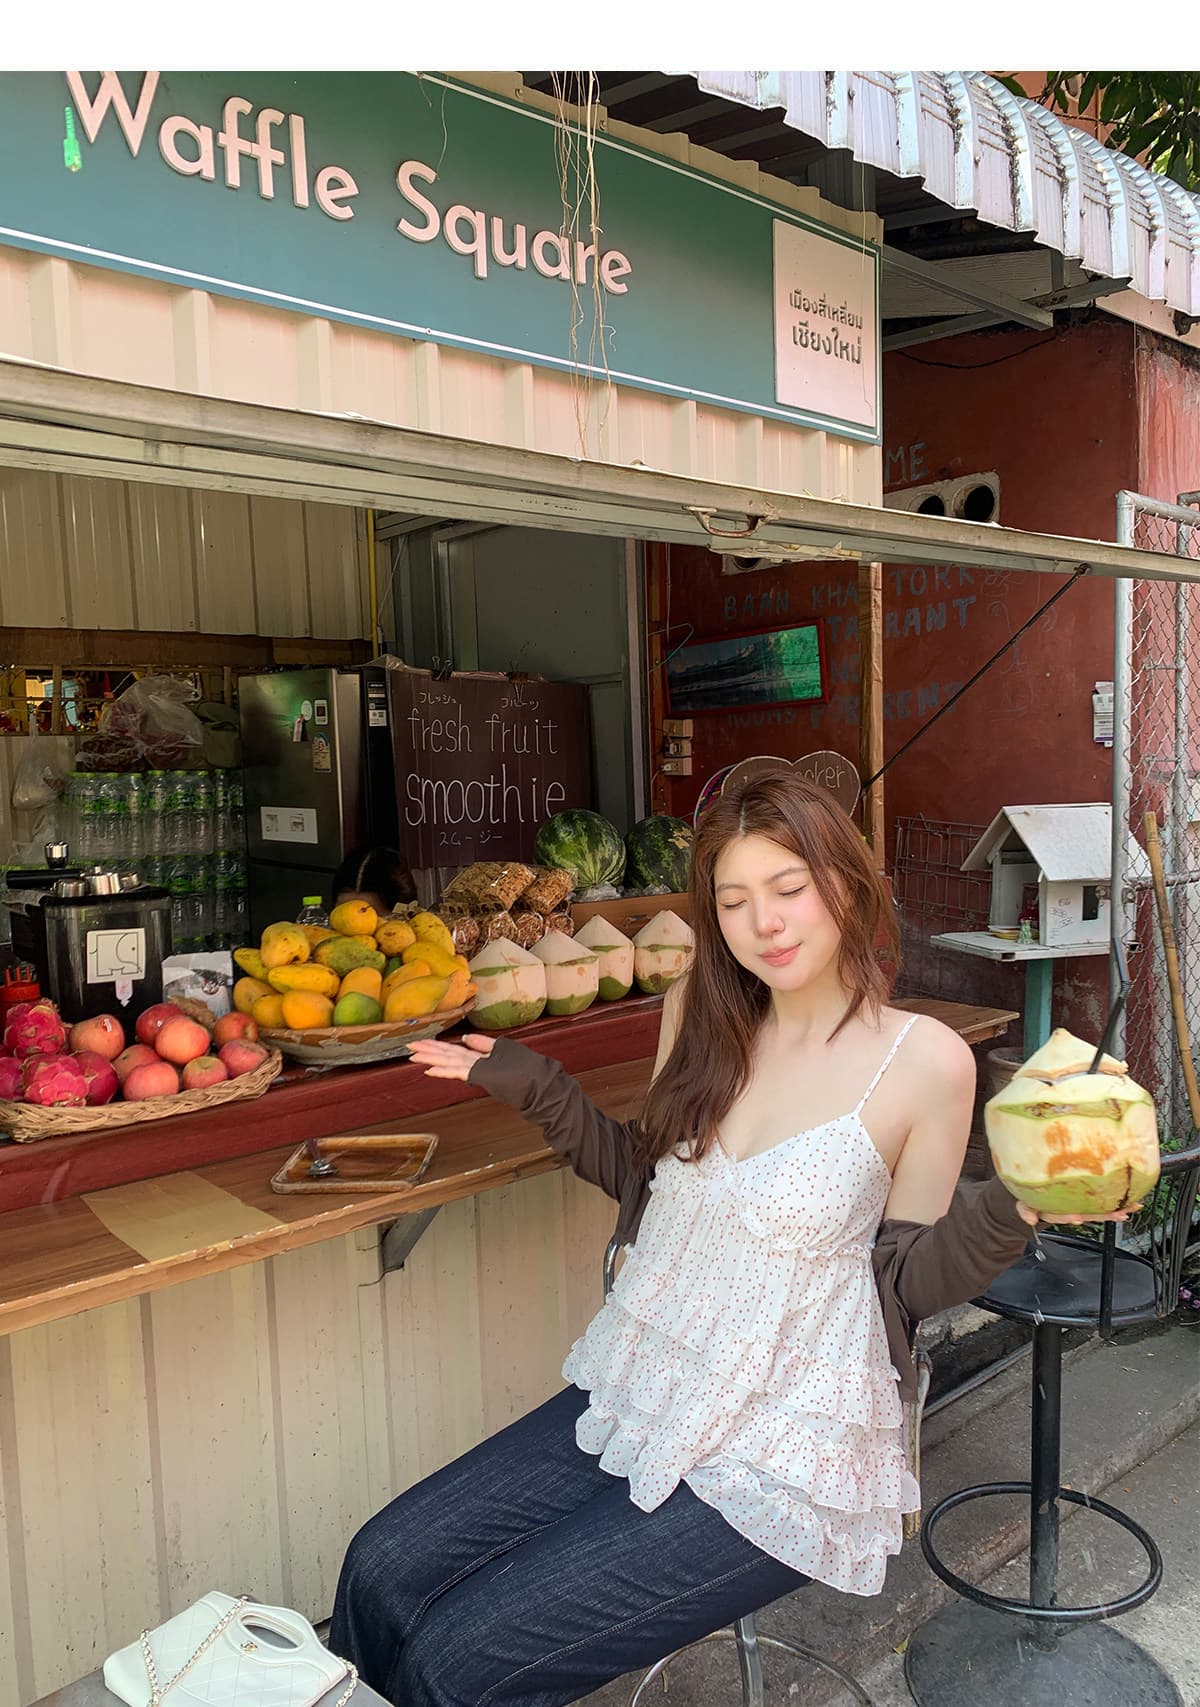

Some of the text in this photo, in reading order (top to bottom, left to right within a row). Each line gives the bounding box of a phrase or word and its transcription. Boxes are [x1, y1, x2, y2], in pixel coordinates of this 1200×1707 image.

[66, 72, 633, 295] Waffle Square
[793, 320, 862, 364] เชียงใหม่
[723, 588, 790, 620] BAAN
[407, 703, 558, 754] fresh fruit
[405, 763, 566, 826] smoothie
